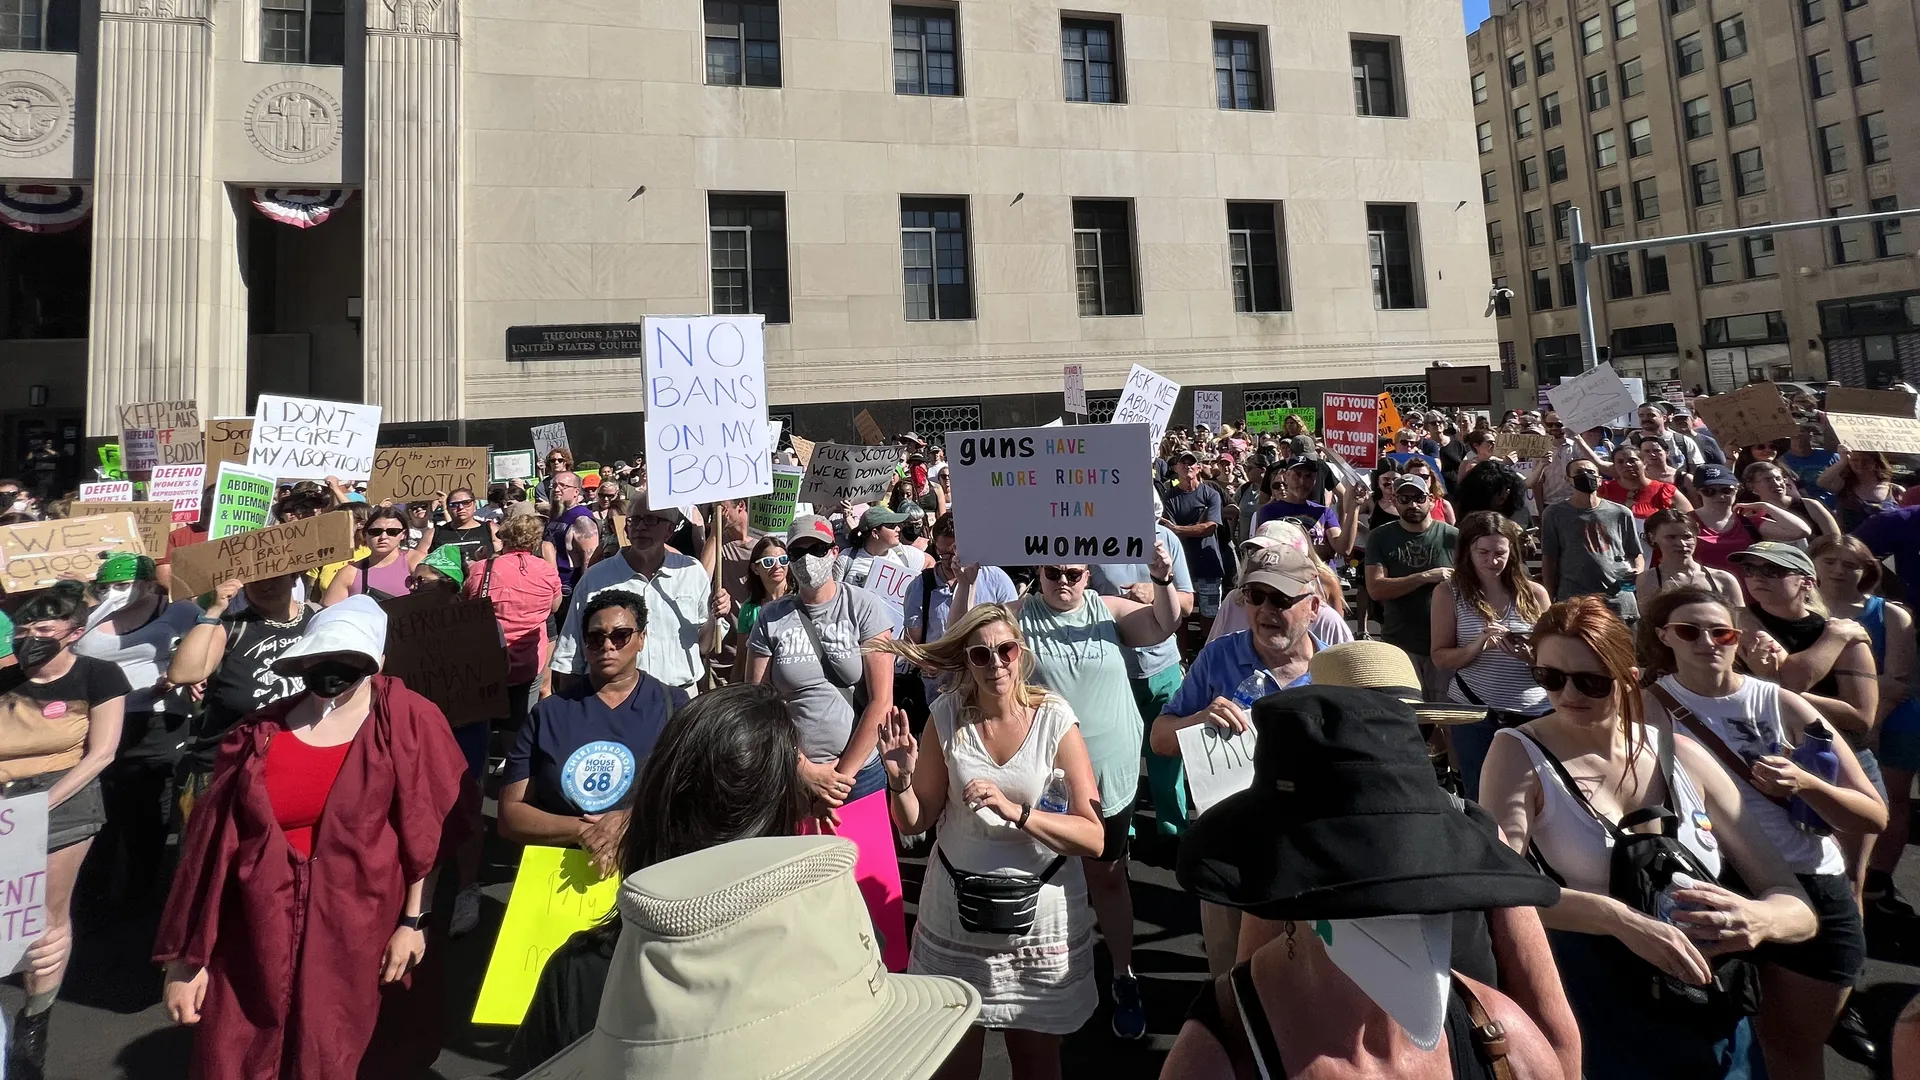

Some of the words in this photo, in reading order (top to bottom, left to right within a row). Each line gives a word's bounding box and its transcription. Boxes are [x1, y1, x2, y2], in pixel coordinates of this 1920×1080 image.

[542, 331, 602, 341] THEODORE
[606, 330, 638, 338] LEVIN
[512, 343, 554, 354] UNITED
[558, 342, 596, 351] STATES
[656, 322, 745, 369] NO
[652, 374, 757, 410] BANS
[1128, 370, 1155, 394] ASK
[1154, 382, 1178, 406] ME
[1196, 391, 1219, 402] FUCK
[1124, 392, 1164, 421] ABOUT
[1326, 396, 1345, 408] NOT
[1347, 397, 1376, 410] YOUR
[120, 402, 165, 430] KEEP
[168, 400, 197, 411] YOUR
[168, 410, 199, 428] LAWS
[263, 402, 268, 422] I
[1194, 410, 1220, 421] SCOTUS
[1336, 410, 1364, 422] BODY
[1836, 414, 1920, 429] ABORTION
[125, 429, 154, 440] DEFEND
[259, 425, 362, 449] REGRET
[658, 423, 704, 452] ON
[722, 418, 756, 448] MY
[1326, 428, 1344, 440] NOT
[1346, 430, 1374, 444] YOUR
[164, 441, 200, 464] BODY
[817, 446, 851, 462] FUCK
[854, 446, 902, 463] SCOTUS
[959, 436, 1036, 467] guns
[1045, 438, 1086, 455] HAVE
[1332, 443, 1368, 457] CHOICE
[128, 458, 158, 470] RIGHTS
[252, 446, 283, 466] MY
[282, 448, 372, 474] ABORTIONS
[425, 454, 453, 469] isn't
[454, 458, 476, 470] my
[154, 467, 204, 478] DEFEND
[668, 447, 770, 496] BODY!
[812, 464, 849, 480] WE'RE
[854, 464, 893, 480] DOING
[990, 470, 1038, 487] MORE
[1056, 468, 1120, 485] RIGHTS
[84, 483, 130, 496] DEFEND
[154, 480, 190, 488] WOMEN'S
[226, 479, 270, 496] ABORTION
[392, 472, 476, 498] SCOTUS
[808, 482, 824, 493] IT
[832, 480, 888, 500] ANYWAYS
[152, 489, 199, 497] REPRODUCTIVE
[220, 494, 234, 506] ON
[237, 496, 270, 512] DEMAND
[759, 503, 793, 514] WITHOUT
[1050, 501, 1094, 518] THAN
[220, 509, 228, 520] &
[754, 517, 787, 528] APOLOGY
[8, 523, 94, 552] WE
[217, 521, 310, 560] ABORTION
[1024, 534, 1144, 558] women
[230, 557, 242, 567] IS
[256, 542, 294, 562] BASIC
[567, 746, 590, 774] CHERI
[594, 744, 630, 774] HARDMON
[583, 772, 612, 792] 68
